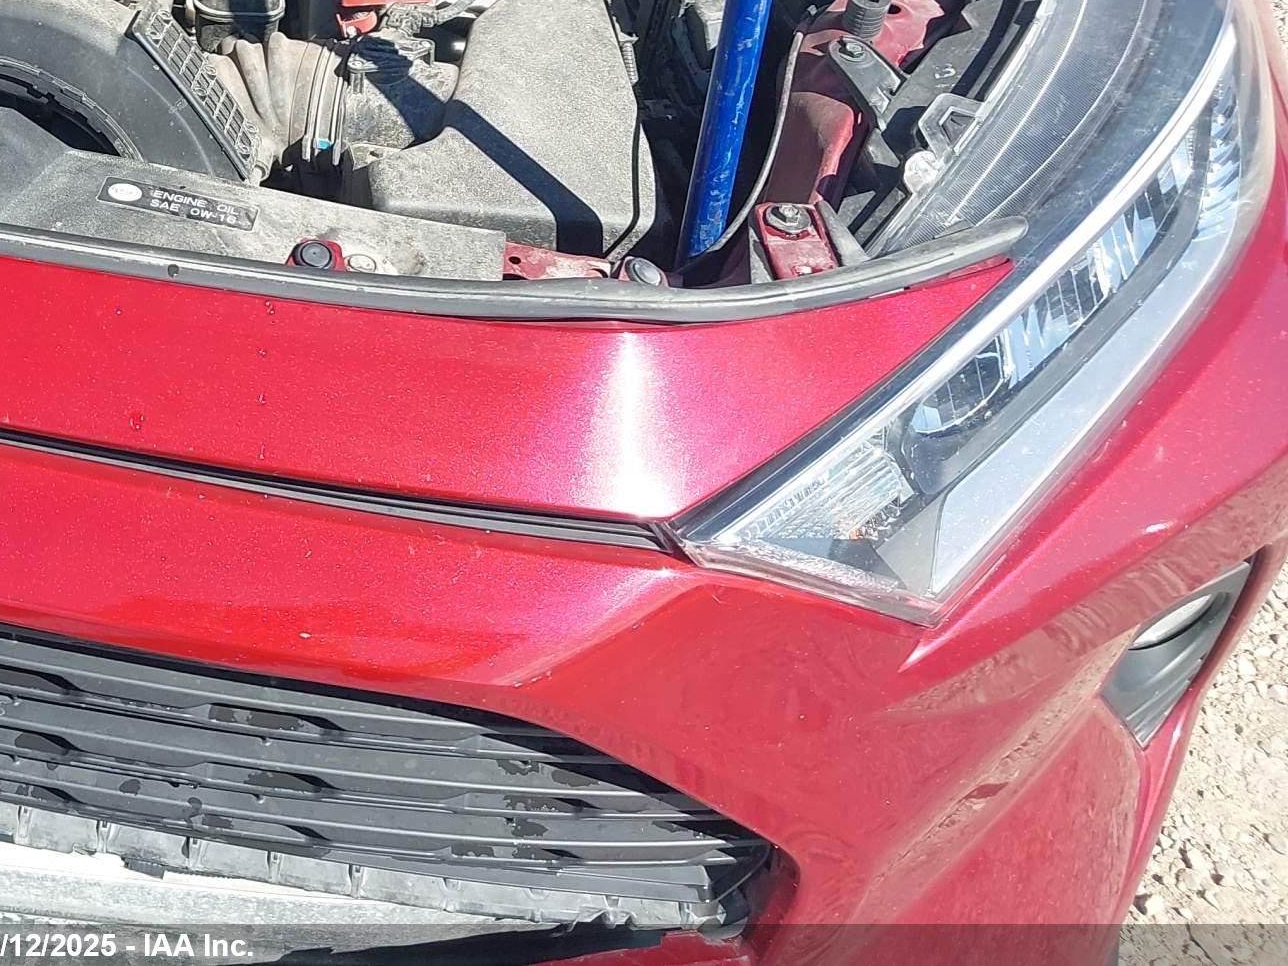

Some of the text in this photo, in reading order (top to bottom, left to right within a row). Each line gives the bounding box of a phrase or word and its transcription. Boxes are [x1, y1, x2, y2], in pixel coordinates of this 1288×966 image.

[150, 199, 237, 224] SAE 0W-16
[152, 190, 209, 208] ENGINE
[216, 204, 239, 215] OIL
